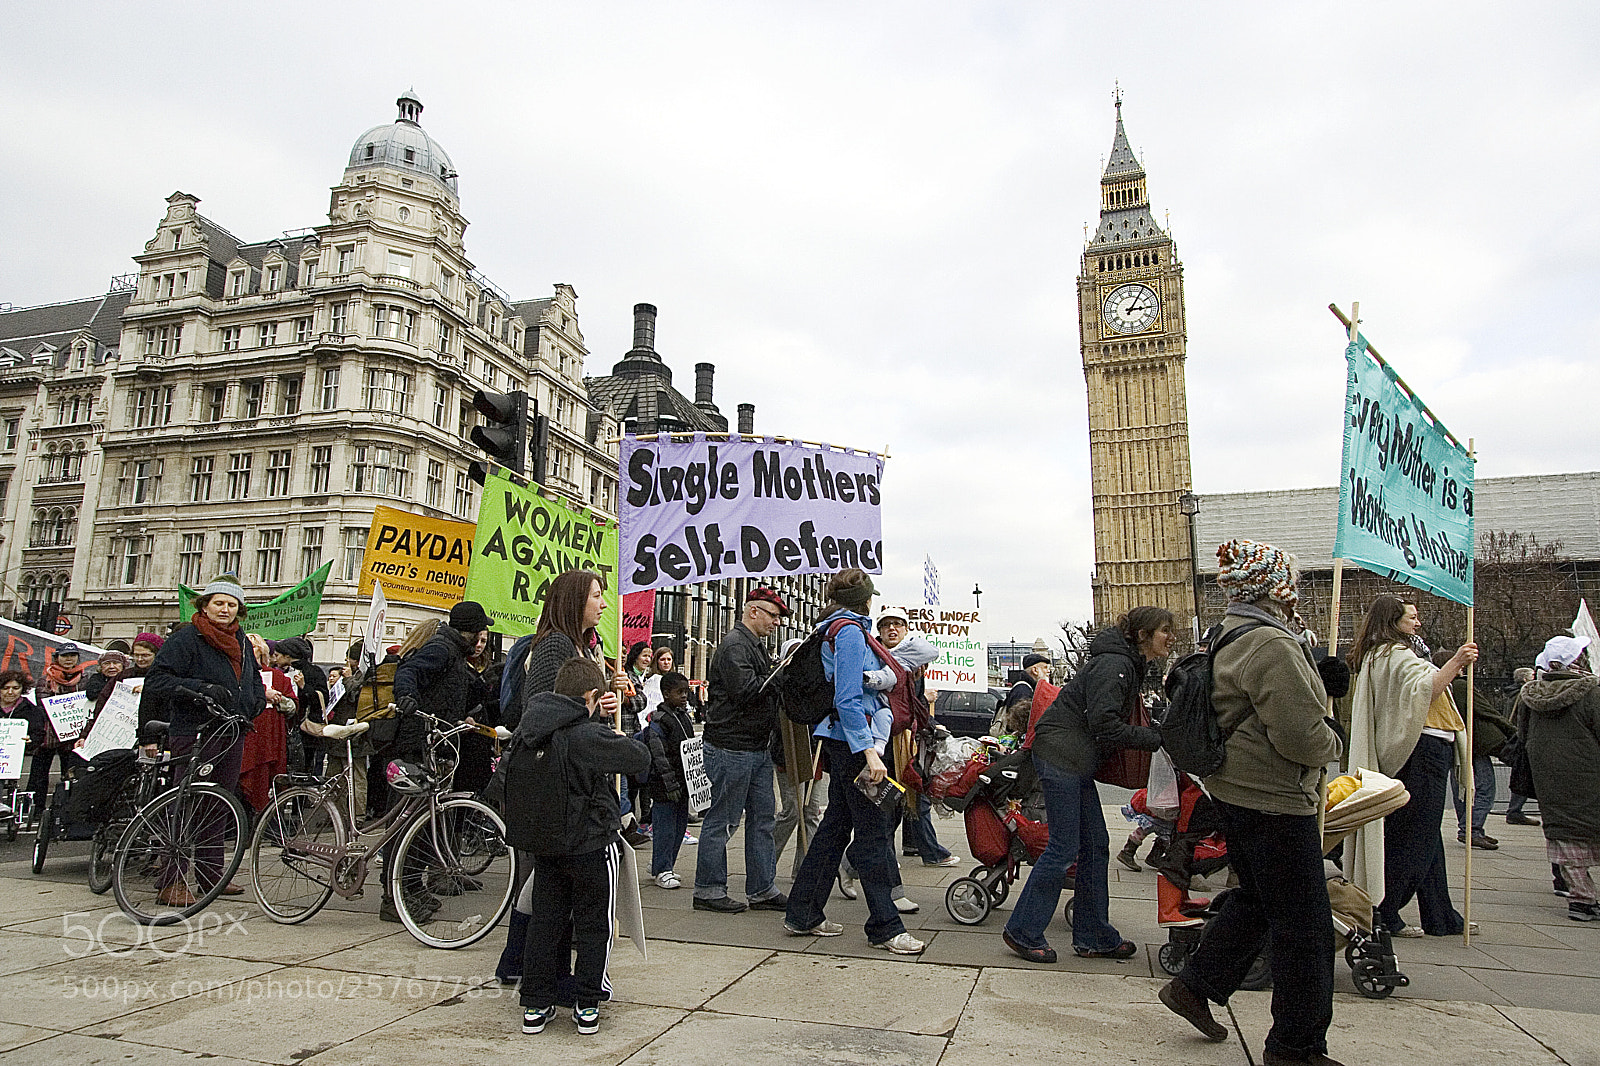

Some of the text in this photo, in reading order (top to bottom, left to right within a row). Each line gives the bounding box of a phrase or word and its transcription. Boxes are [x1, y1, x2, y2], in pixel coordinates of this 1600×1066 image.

[1391, 414, 1436, 499] Mother
[1442, 466, 1457, 510] is
[626, 445, 739, 515] Single
[505, 491, 604, 559] WOMEN
[1350, 468, 1417, 569] Working
[370, 561, 467, 588] men's netwo
[382, 581, 415, 593] counting
[425, 588, 455, 601] unwaged
[249, 605, 304, 621] with Visible
[264, 612, 314, 629] Disabilities
[940, 611, 981, 623] UNDER
